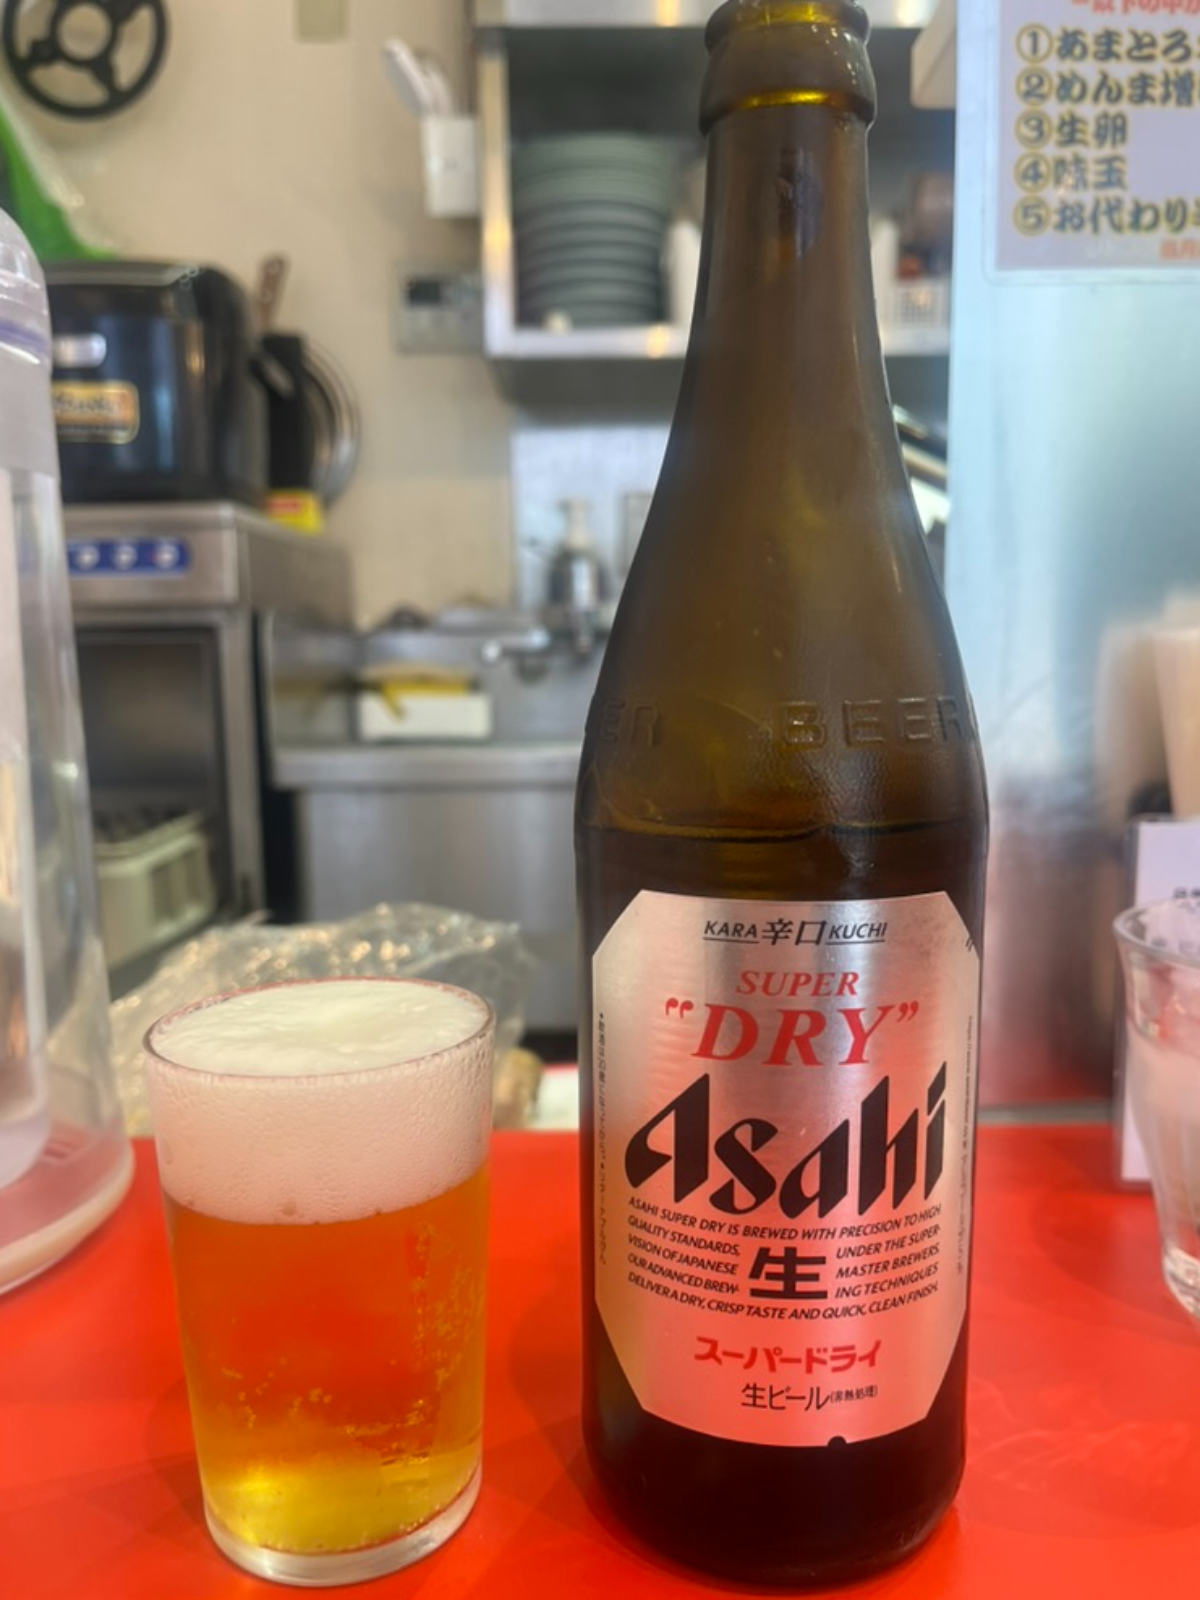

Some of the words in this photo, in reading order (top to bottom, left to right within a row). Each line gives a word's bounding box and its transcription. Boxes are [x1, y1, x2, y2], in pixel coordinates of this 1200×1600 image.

[1016, 22, 1200, 63] ①あまとろ
[1015, 65, 1200, 108] ②めんま増
[704, 920, 759, 939] KARA
[762, 918, 828, 946] 辛口
[828, 921, 888, 940] KUCHI
[736, 970, 860, 997] SUPER
[624, 1060, 947, 1219] Asahi
[628, 1197, 660, 1216] ASAHI
[660, 1208, 697, 1228] SUPER
[699, 1219, 727, 1233] DRY
[727, 1224, 740, 1236] IS
[742, 1226, 798, 1240] BREWED
[801, 1227, 837, 1240] WITH
[838, 1218, 902, 1239] PRECISION
[903, 1213, 918, 1227] TO
[917, 1203, 942, 1222] HIGH
[628, 1215, 670, 1240] QUALITY
[670, 1231, 741, 1257] STANDARDS,
[836, 1243, 883, 1259] UNDER
[884, 1236, 907, 1252] THE
[627, 1253, 648, 1270] OUR
[646, 1262, 703, 1289] ADVANCED
[704, 1279, 739, 1295] BREW-
[835, 1284, 862, 1300] ING
[864, 1261, 940, 1296] TECHNIQUES
[628, 1233, 662, 1256] VISION
[662, 1248, 678, 1262] OF
[677, 1252, 739, 1276] JAPANESE
[835, 1260, 891, 1279] MASTER
[748, 1246, 828, 1300] 生
[628, 1272, 670, 1298] DELIVER
[669, 1290, 679, 1302] A
[679, 1291, 706, 1310] DRY,
[707, 1299, 745, 1315] CRISP
[745, 1305, 787, 1320] TASTE
[788, 1307, 821, 1321] AND
[868, 1295, 907, 1314] CLEAN
[694, 1335, 882, 1375] スーパードライ
